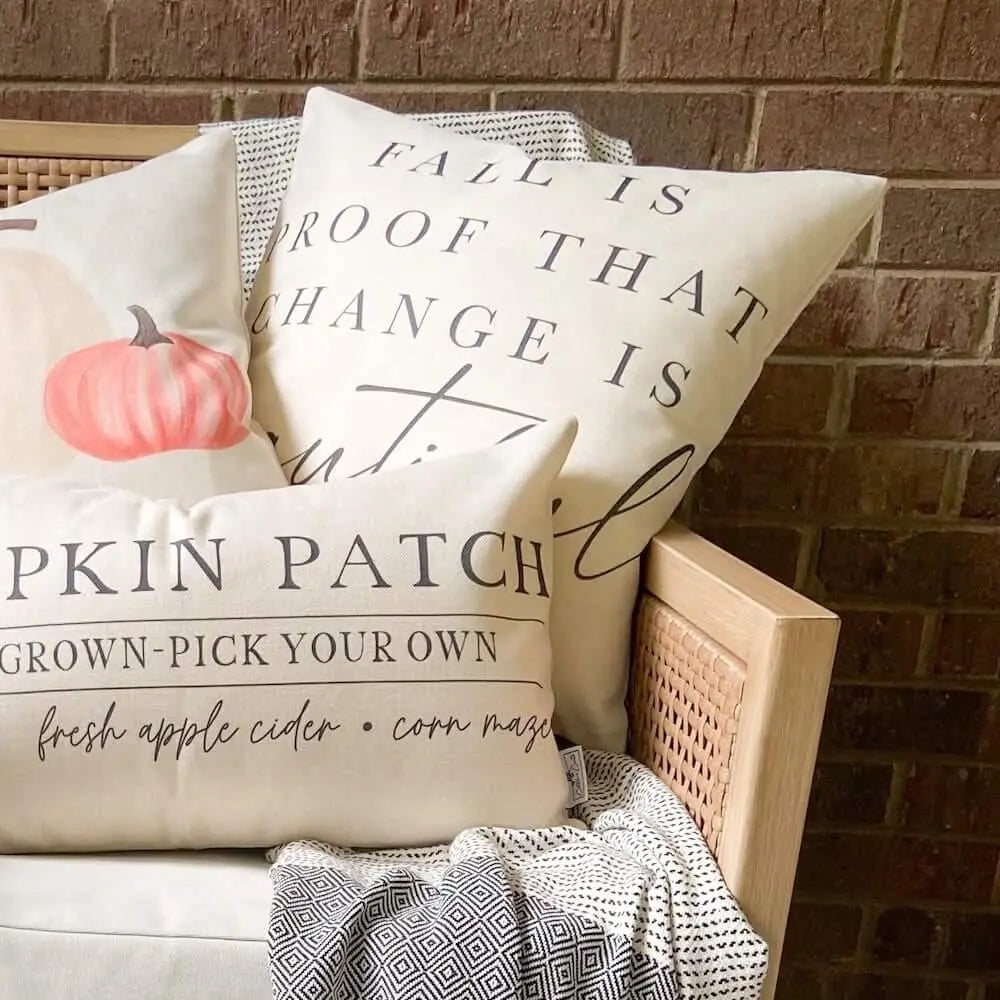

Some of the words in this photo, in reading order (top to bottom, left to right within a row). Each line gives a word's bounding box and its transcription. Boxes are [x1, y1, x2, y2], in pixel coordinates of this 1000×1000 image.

[367, 142, 553, 187] FALL
[603, 175, 692, 216] IS
[265, 204, 489, 263] PROOF
[534, 229, 769, 344] THAT
[251, 285, 558, 365] CHANGE
[603, 341, 692, 409] IS
[277, 530, 551, 599] PATCH
[282, 631, 397, 664] YOUR
[407, 629, 498, 664] OWN
[38, 700, 128, 762] fresh
[138, 699, 240, 762] apple
[249, 698, 341, 752] cider
[393, 715, 471, 741] corn
